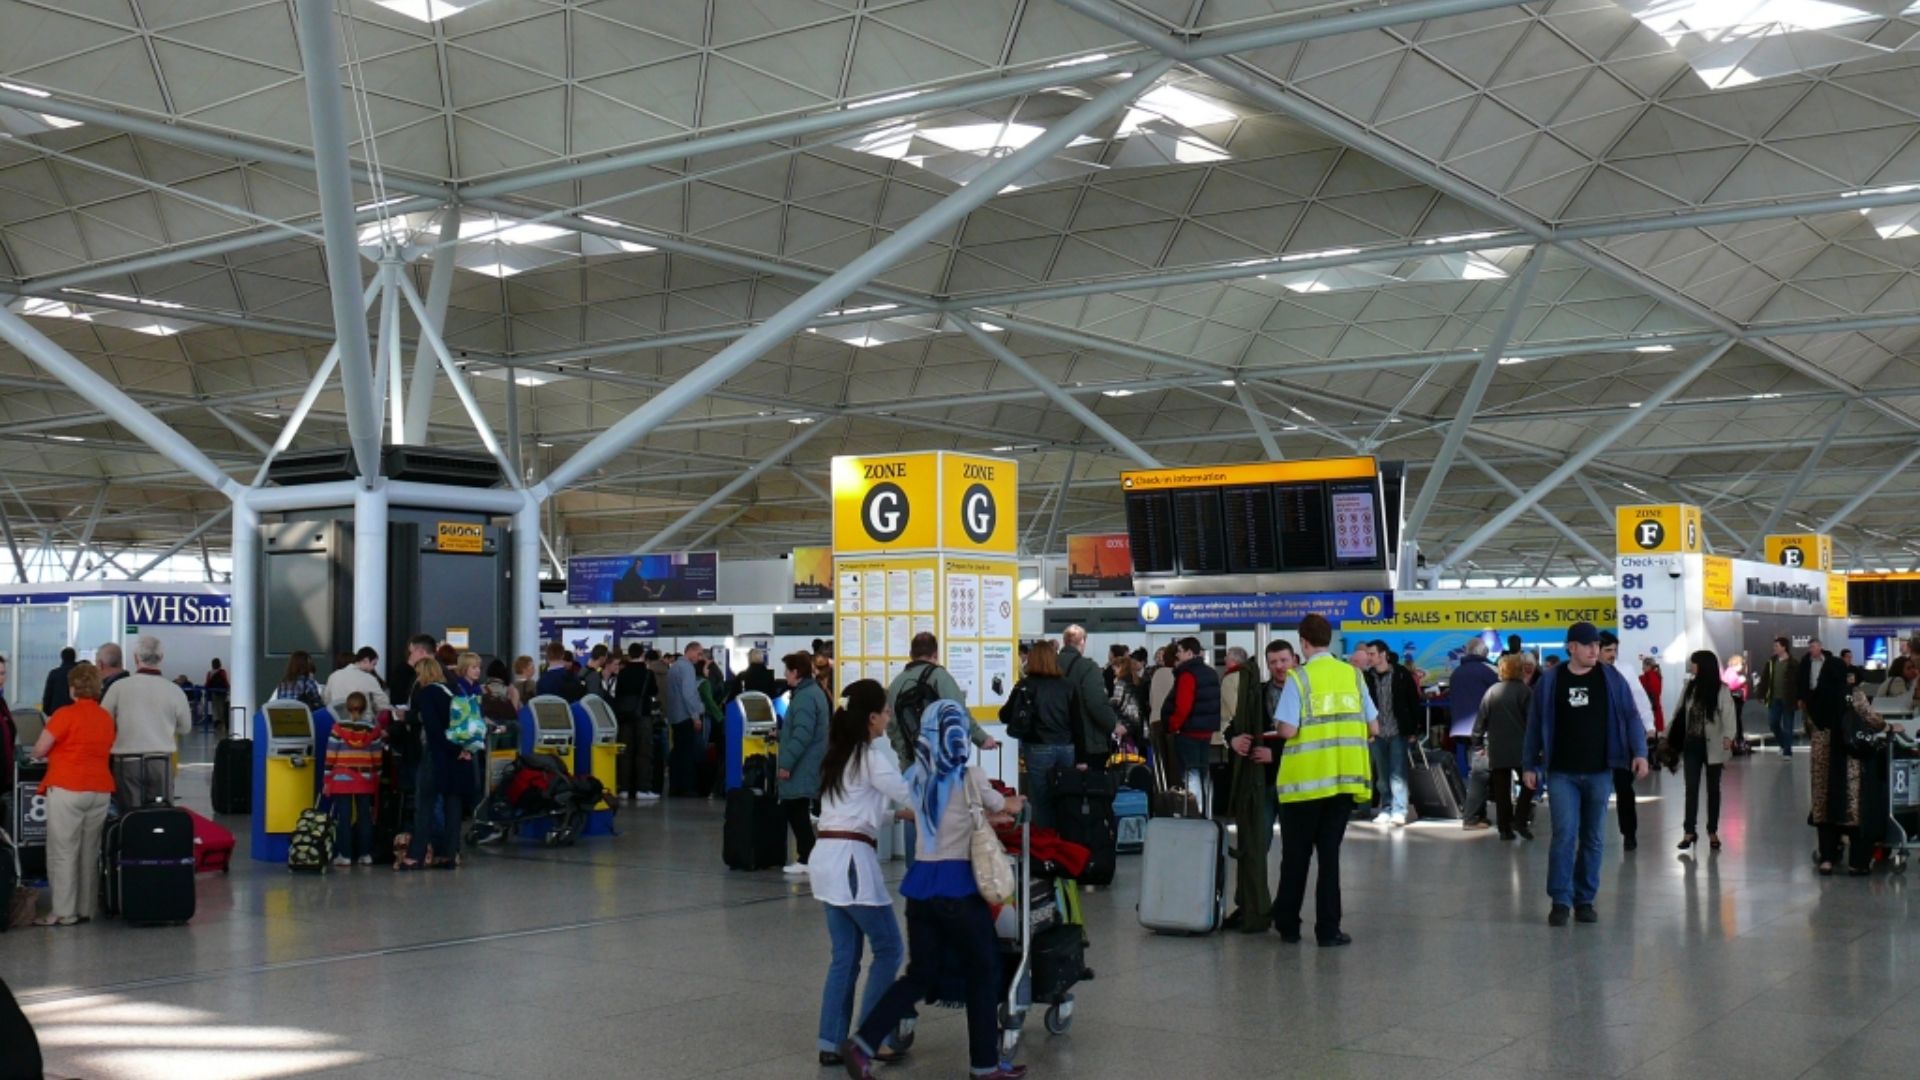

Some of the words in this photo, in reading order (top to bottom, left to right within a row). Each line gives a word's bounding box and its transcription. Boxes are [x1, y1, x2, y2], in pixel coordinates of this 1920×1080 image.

[864, 463, 907, 479] ZONE
[963, 463, 995, 481] ZONE
[869, 491, 901, 533] G
[966, 492, 991, 534] G
[1635, 510, 1663, 518] ZONE
[1640, 523, 1659, 545] F
[1785, 549, 1800, 568] E
[1621, 573, 1643, 589] 81
[1621, 594, 1643, 609] to
[1403, 610, 1441, 625] SALES
[1454, 610, 1497, 624] TICKET
[1500, 608, 1540, 623] SALES
[1554, 608, 1600, 622] TICKET
[1623, 613, 1649, 630] 96
